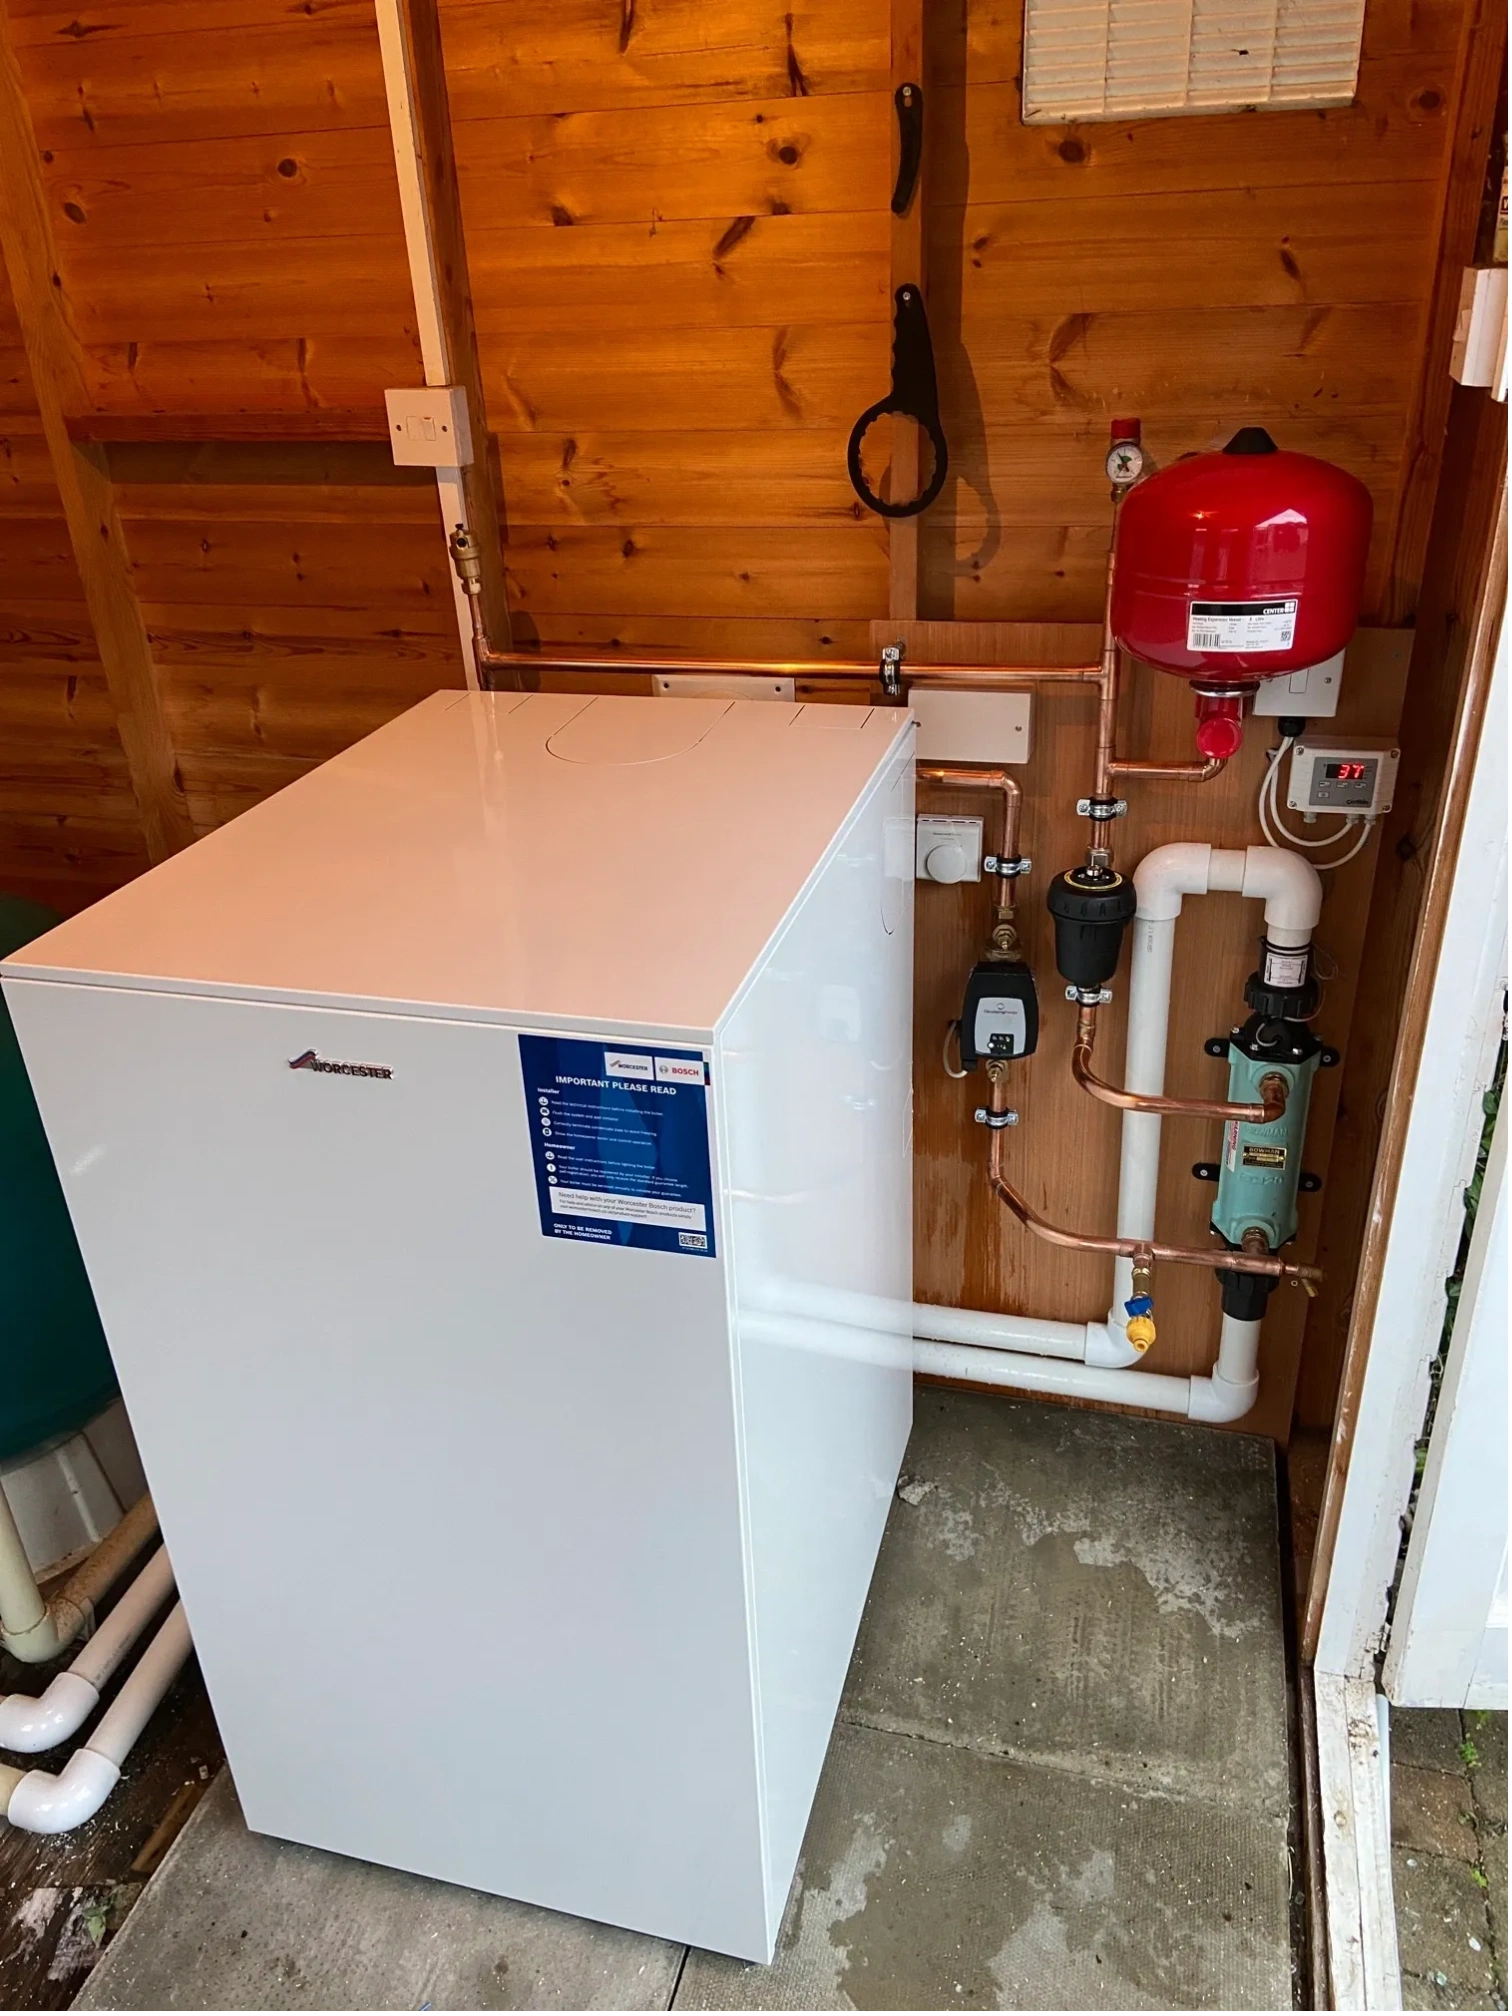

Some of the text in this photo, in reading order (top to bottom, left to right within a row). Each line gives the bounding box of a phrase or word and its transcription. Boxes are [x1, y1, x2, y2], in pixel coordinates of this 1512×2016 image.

[311, 1060, 393, 1079] WORCESTER
[672, 1067, 699, 1076] BOSCH
[555, 1075, 677, 1095] IMPORTANT PLEASE READ
[544, 1142, 575, 1150] Homeowner
[1248, 1147, 1280, 1155] BOWMAN
[617, 1199, 647, 1208] Worcester
[669, 1205, 696, 1214] product?
[574, 1231, 610, 1240] HOMEOWNER
